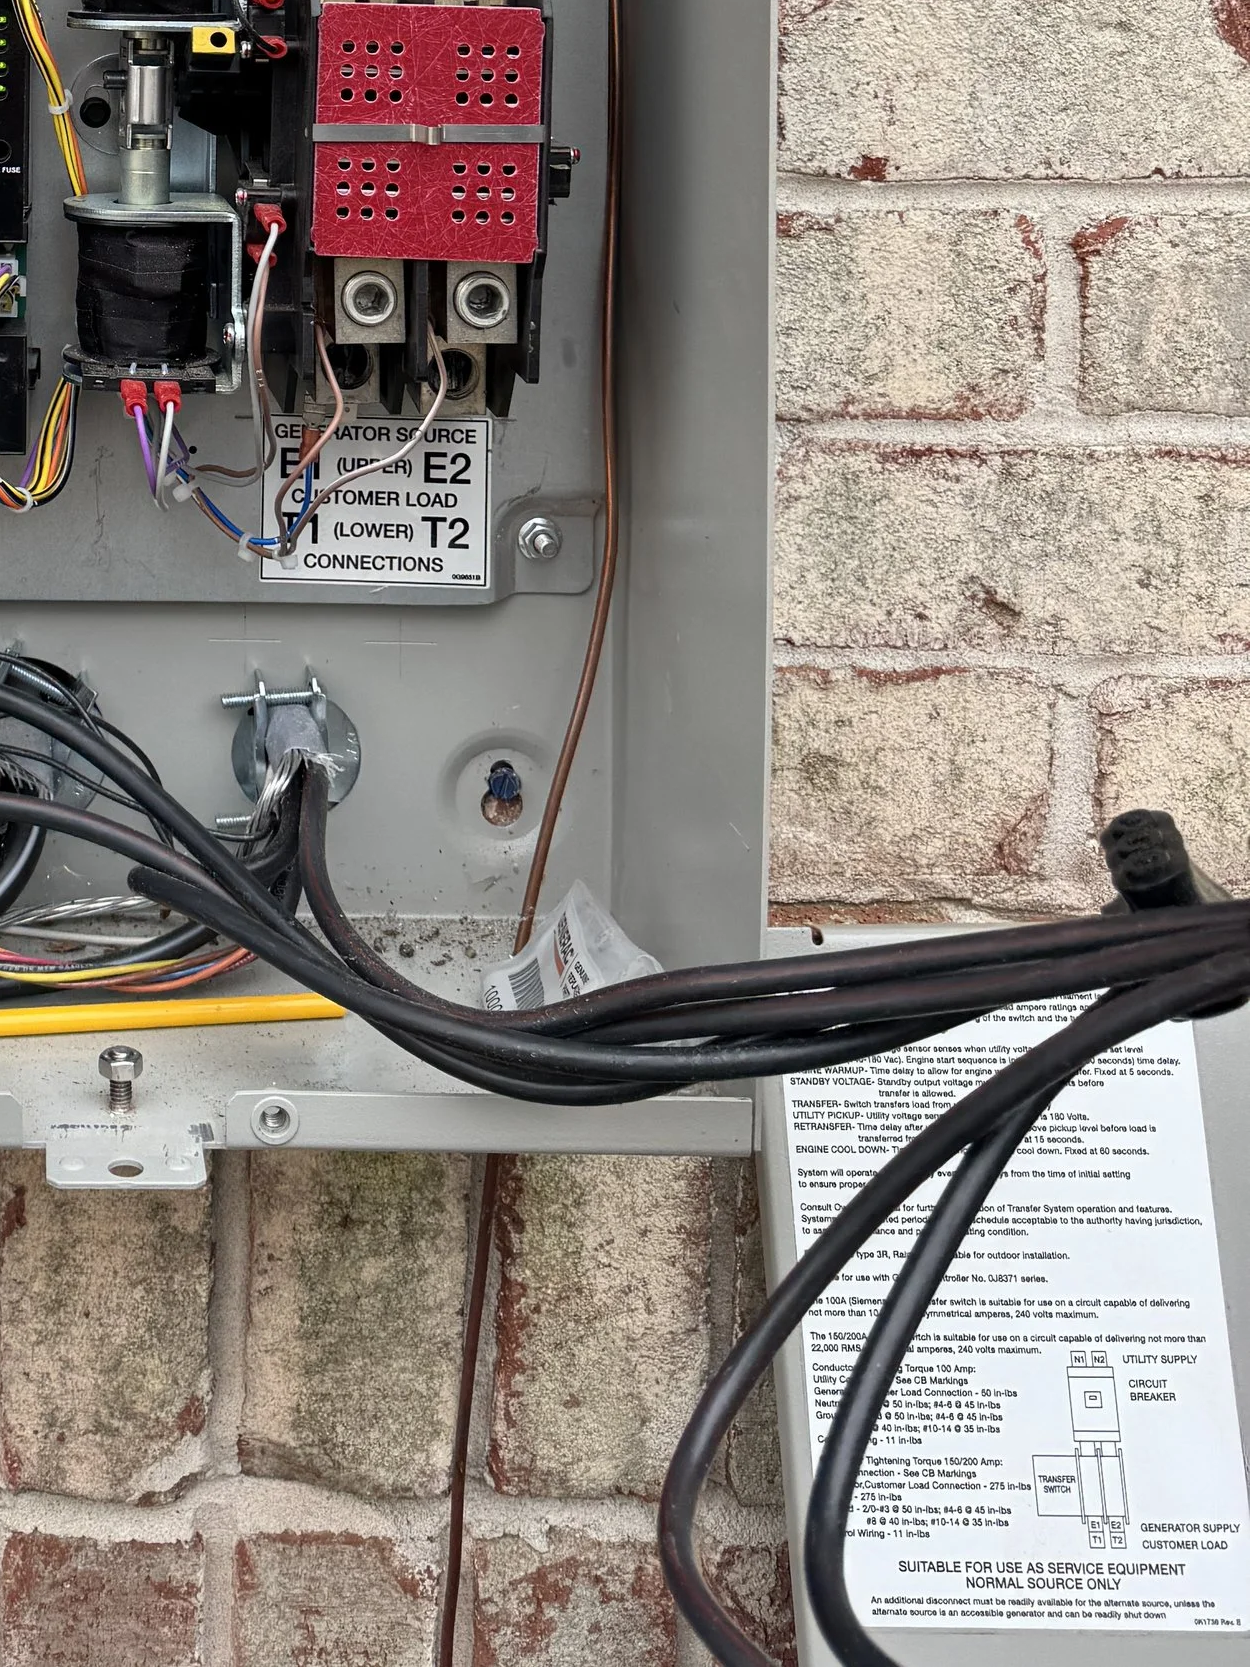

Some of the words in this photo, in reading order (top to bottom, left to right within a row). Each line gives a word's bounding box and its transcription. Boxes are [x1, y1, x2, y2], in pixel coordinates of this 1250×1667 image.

[424, 451, 471, 484] E2
[406, 493, 457, 508] LOAD
[334, 522, 413, 541] (LOWER)
[422, 516, 470, 549] T2
[304, 554, 443, 571] CONNECTIONS
[833, 1078, 874, 1086] VOLTAGE-
[792, 1100, 841, 1108] TRANSFER-
[793, 1112, 824, 1120] UTILITY
[828, 1112, 863, 1120] PICKUP-
[1007, 1205, 1041, 1213] Transfer
[1044, 1205, 1074, 1214] System
[1077, 1205, 1116, 1214] operation
[1123, 1355, 1157, 1363] UTILITY
[1161, 1355, 1198, 1364] SUPPLY
[1129, 1380, 1167, 1388] CIRCUIT
[1130, 1393, 1176, 1401] BREAKER
[866, 1456, 910, 1466] Tightening
[914, 1457, 942, 1467] Torque
[981, 1458, 1002, 1467] Amp:
[1141, 1524, 1200, 1532] GENERATOR
[1203, 1524, 1240, 1532] SUPPLY
[1143, 1541, 1198, 1549] CUSTOMER
[1201, 1541, 1228, 1549] LOAD
[899, 1561, 961, 1572] SUITABLE
[966, 1562, 992, 1573] FOR
[997, 1562, 1023, 1573] USE
[1027, 1563, 1044, 1573] AS
[1048, 1563, 1103, 1574] SERVICE
[1108, 1563, 1185, 1575] EQUIPMENT
[967, 1577, 1023, 1589] NORMAL
[1028, 1578, 1083, 1589] SOURCE
[1087, 1578, 1121, 1590] ONLY
